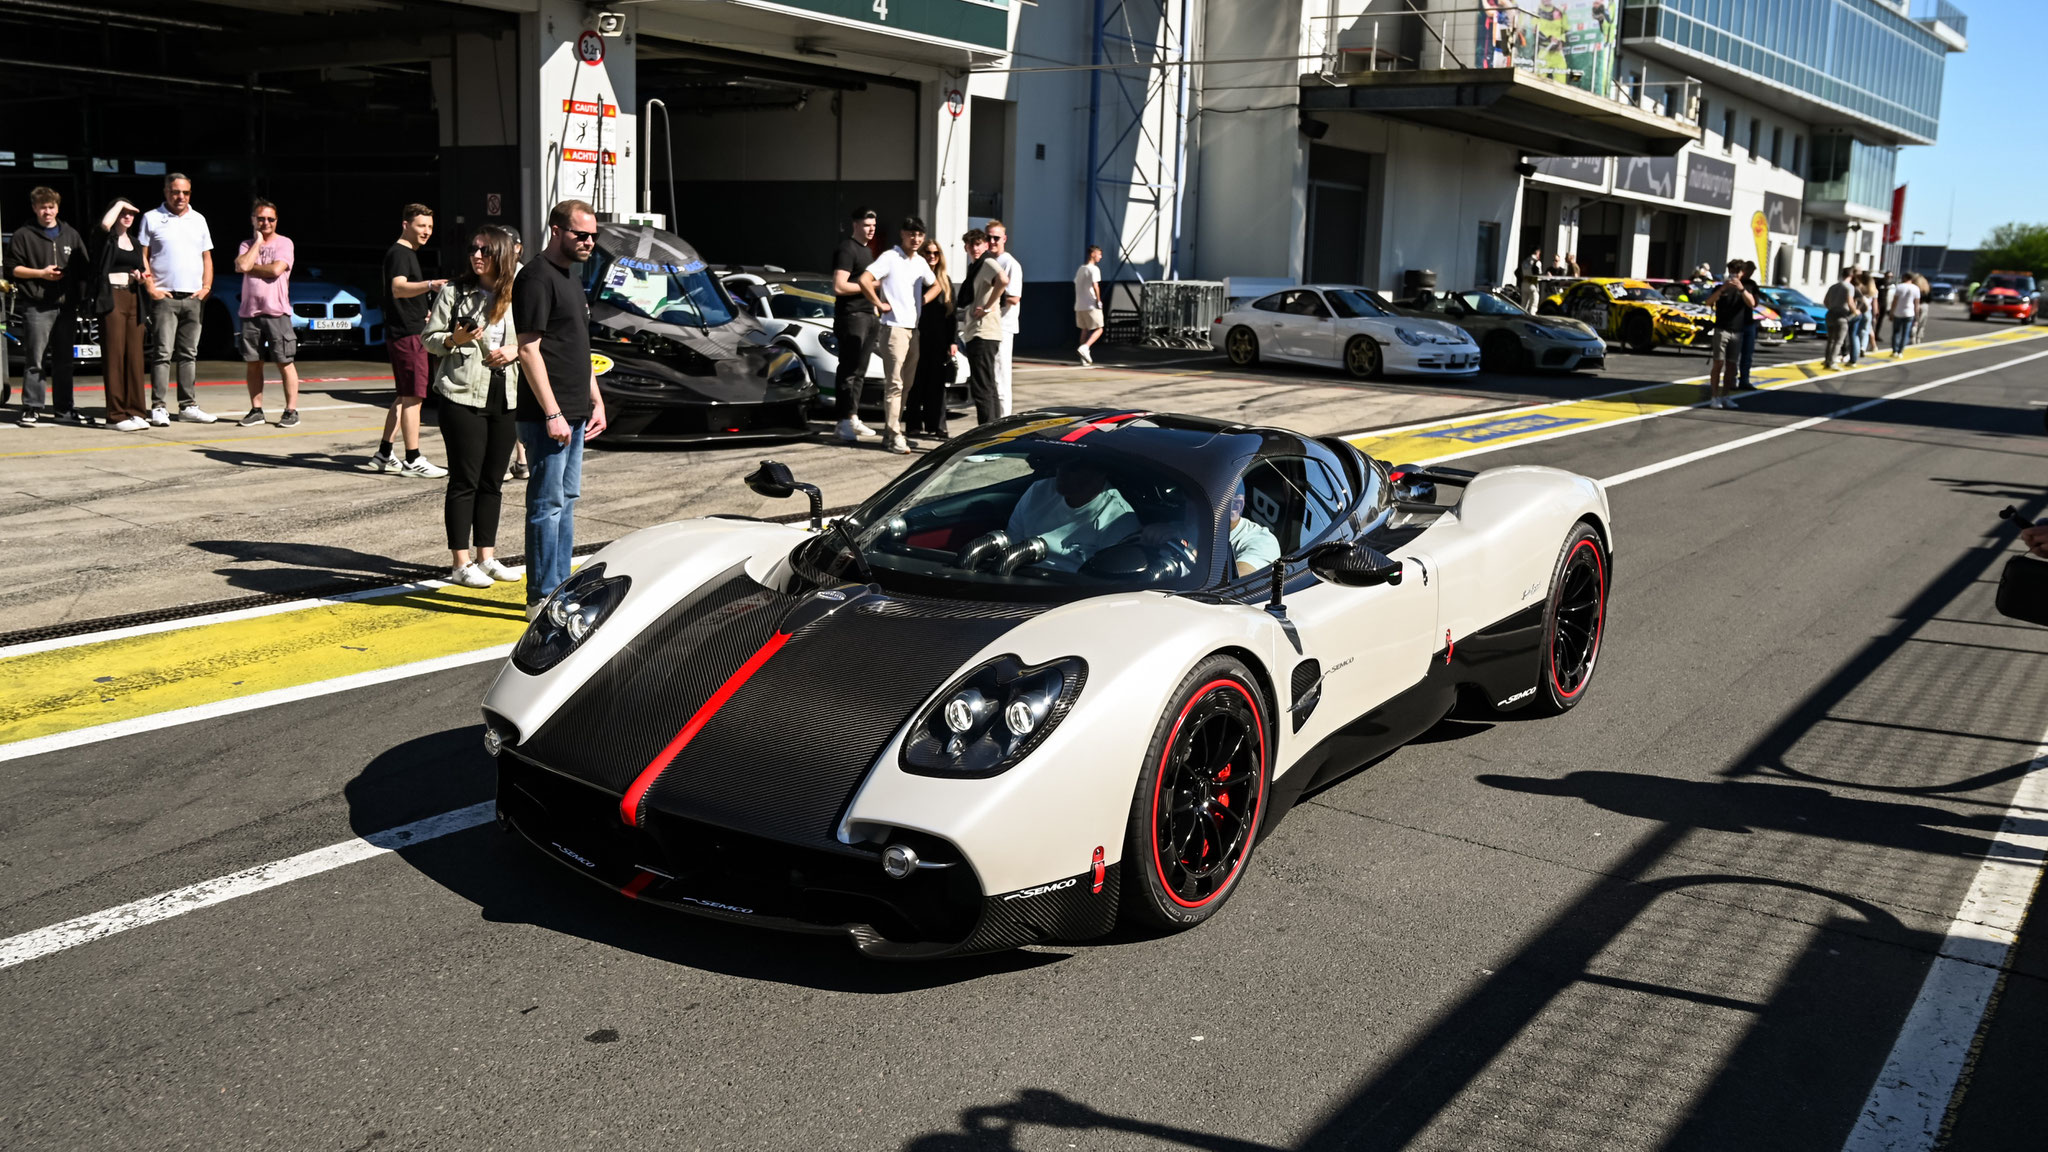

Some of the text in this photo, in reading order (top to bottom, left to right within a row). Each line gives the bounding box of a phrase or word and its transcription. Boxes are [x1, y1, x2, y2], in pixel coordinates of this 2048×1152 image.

[872, 0, 889, 21] 4
[618, 257, 660, 272] READY
[1330, 656, 1355, 673] SEMCO
[1506, 686, 1537, 704] SEMCO
[561, 847, 596, 868] SEMCO
[1019, 879, 1076, 898] SEMCO
[699, 899, 754, 914] SEMCO
